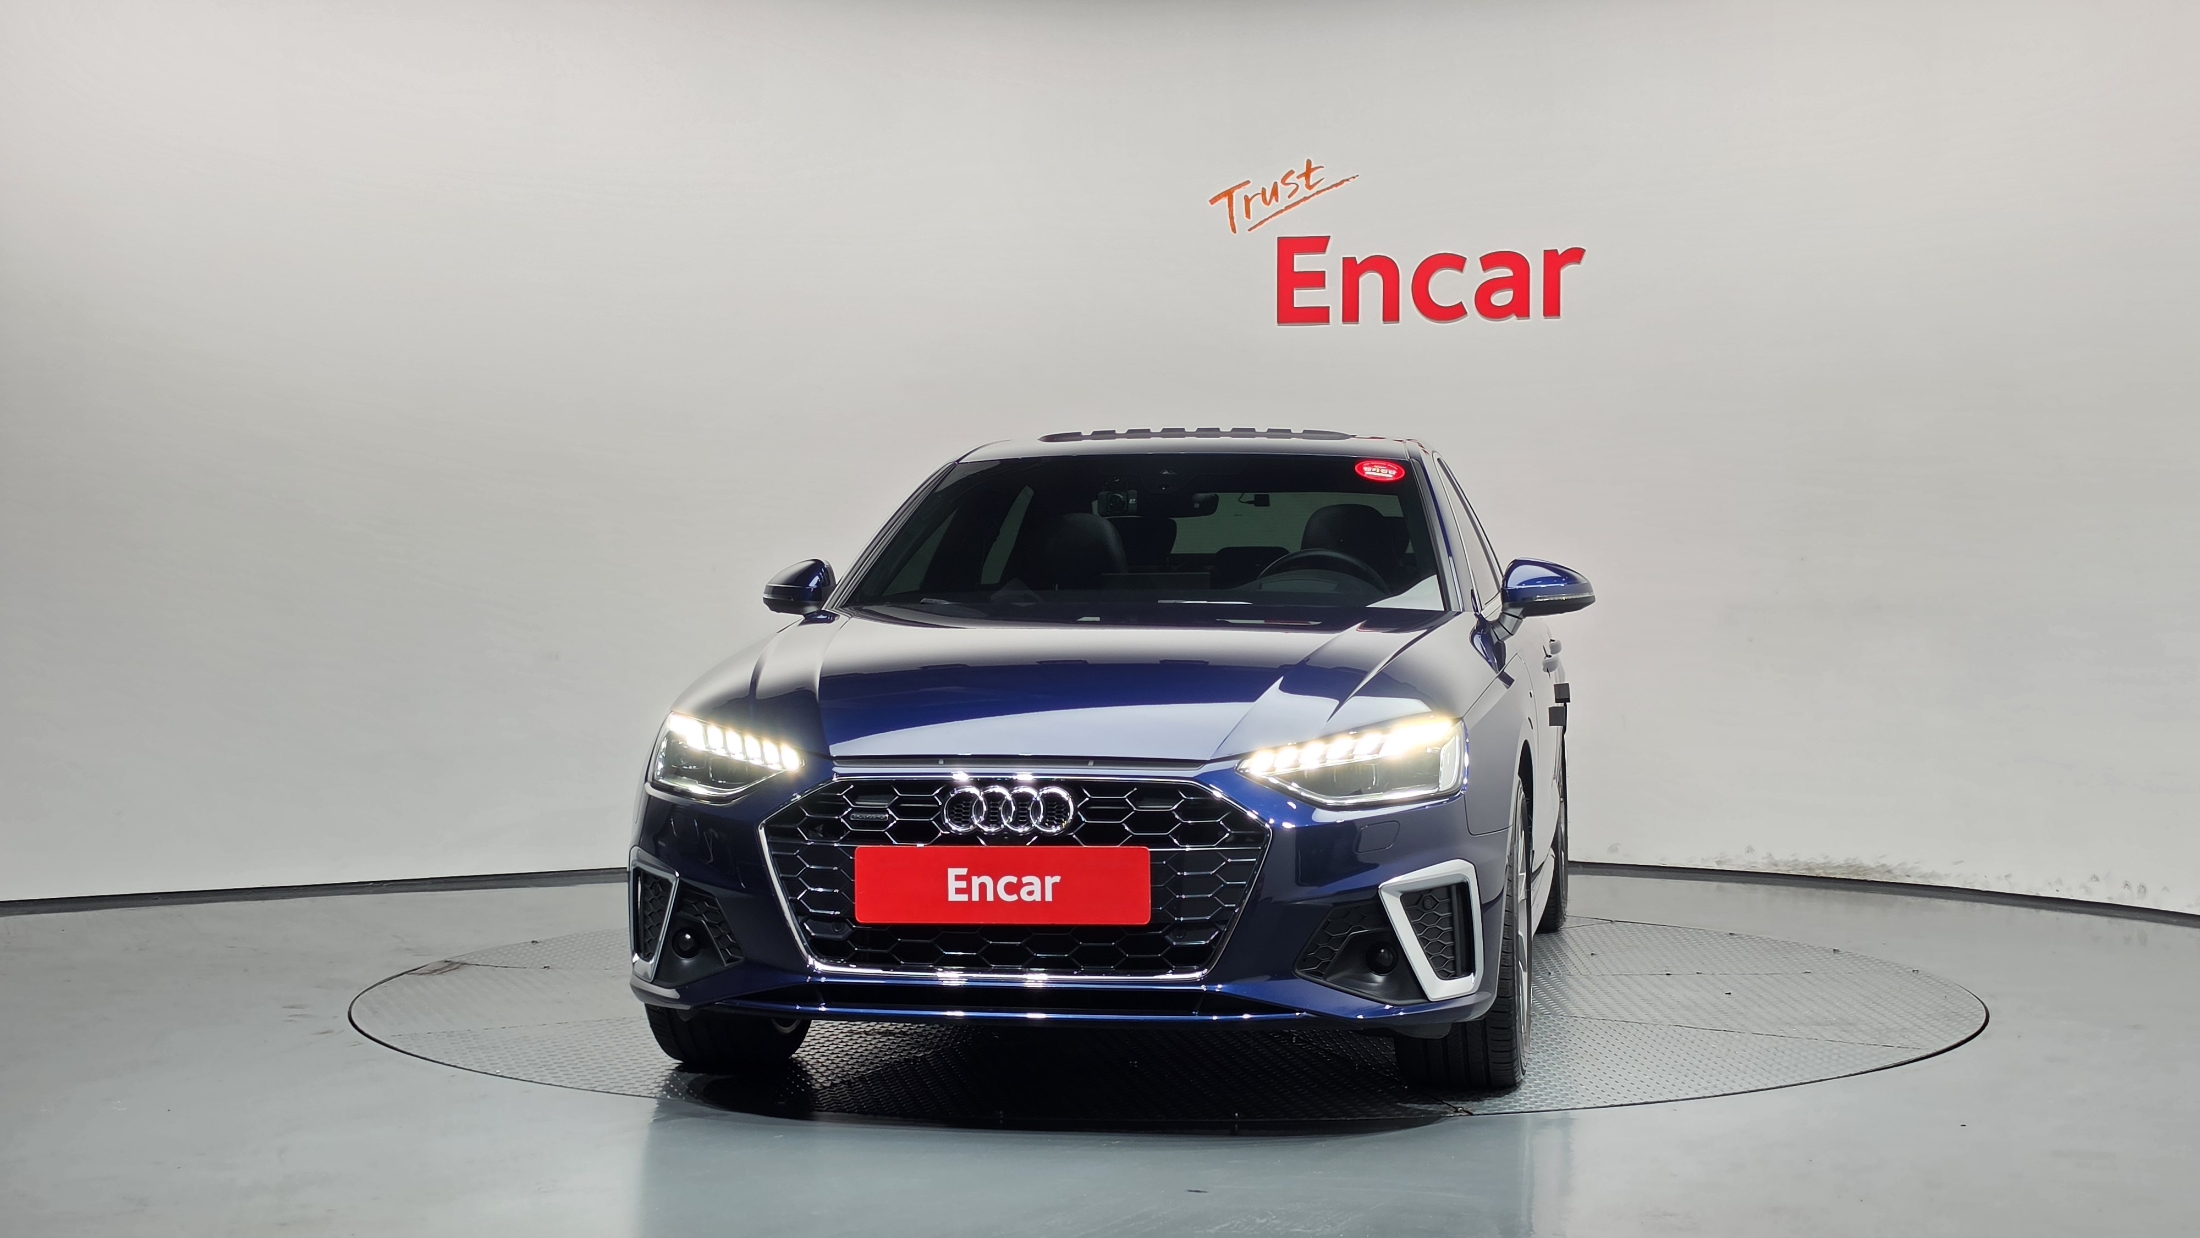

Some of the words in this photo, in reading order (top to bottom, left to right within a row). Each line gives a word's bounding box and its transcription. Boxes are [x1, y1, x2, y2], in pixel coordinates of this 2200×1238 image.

[1208, 158, 1327, 235] Trust
[1276, 235, 1586, 326] Encar
[946, 867, 1061, 902] Encar
